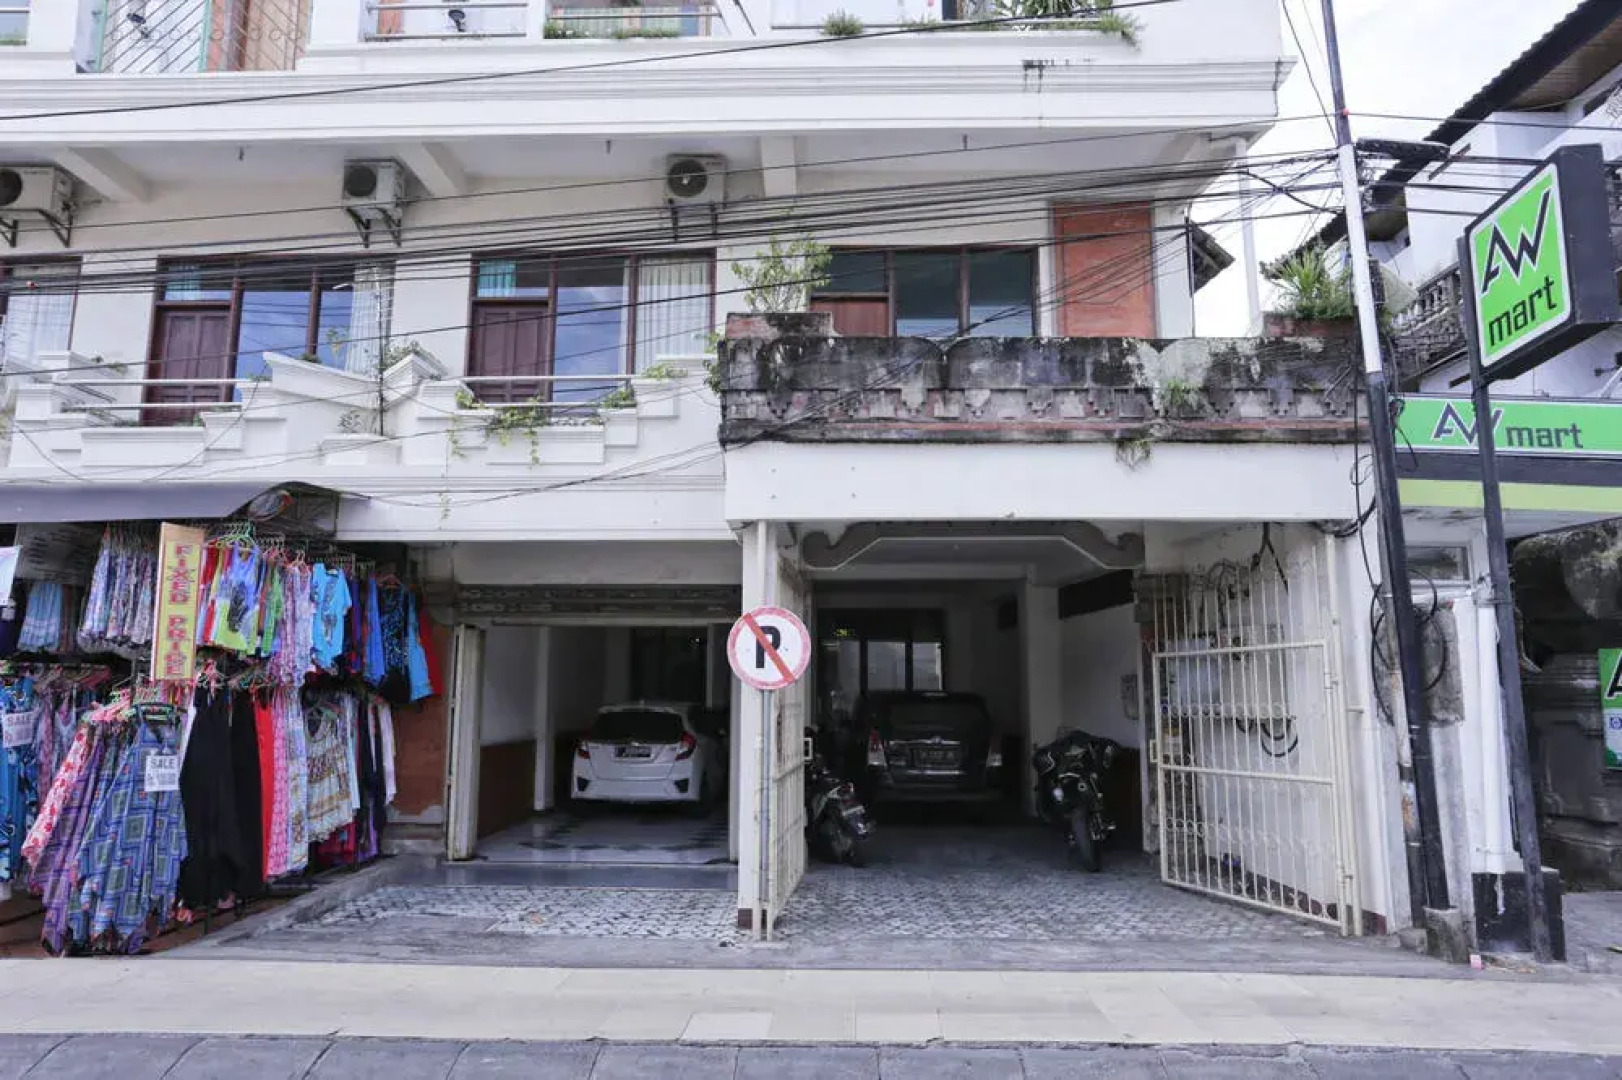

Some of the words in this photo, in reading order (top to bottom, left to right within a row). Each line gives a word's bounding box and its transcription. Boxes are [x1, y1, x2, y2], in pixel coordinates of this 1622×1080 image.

[1482, 189, 1551, 294] AW
[1488, 275, 1557, 347] mart
[1505, 422, 1583, 448] mart
[755, 625, 781, 669] P
[150, 757, 178, 769] SALE
